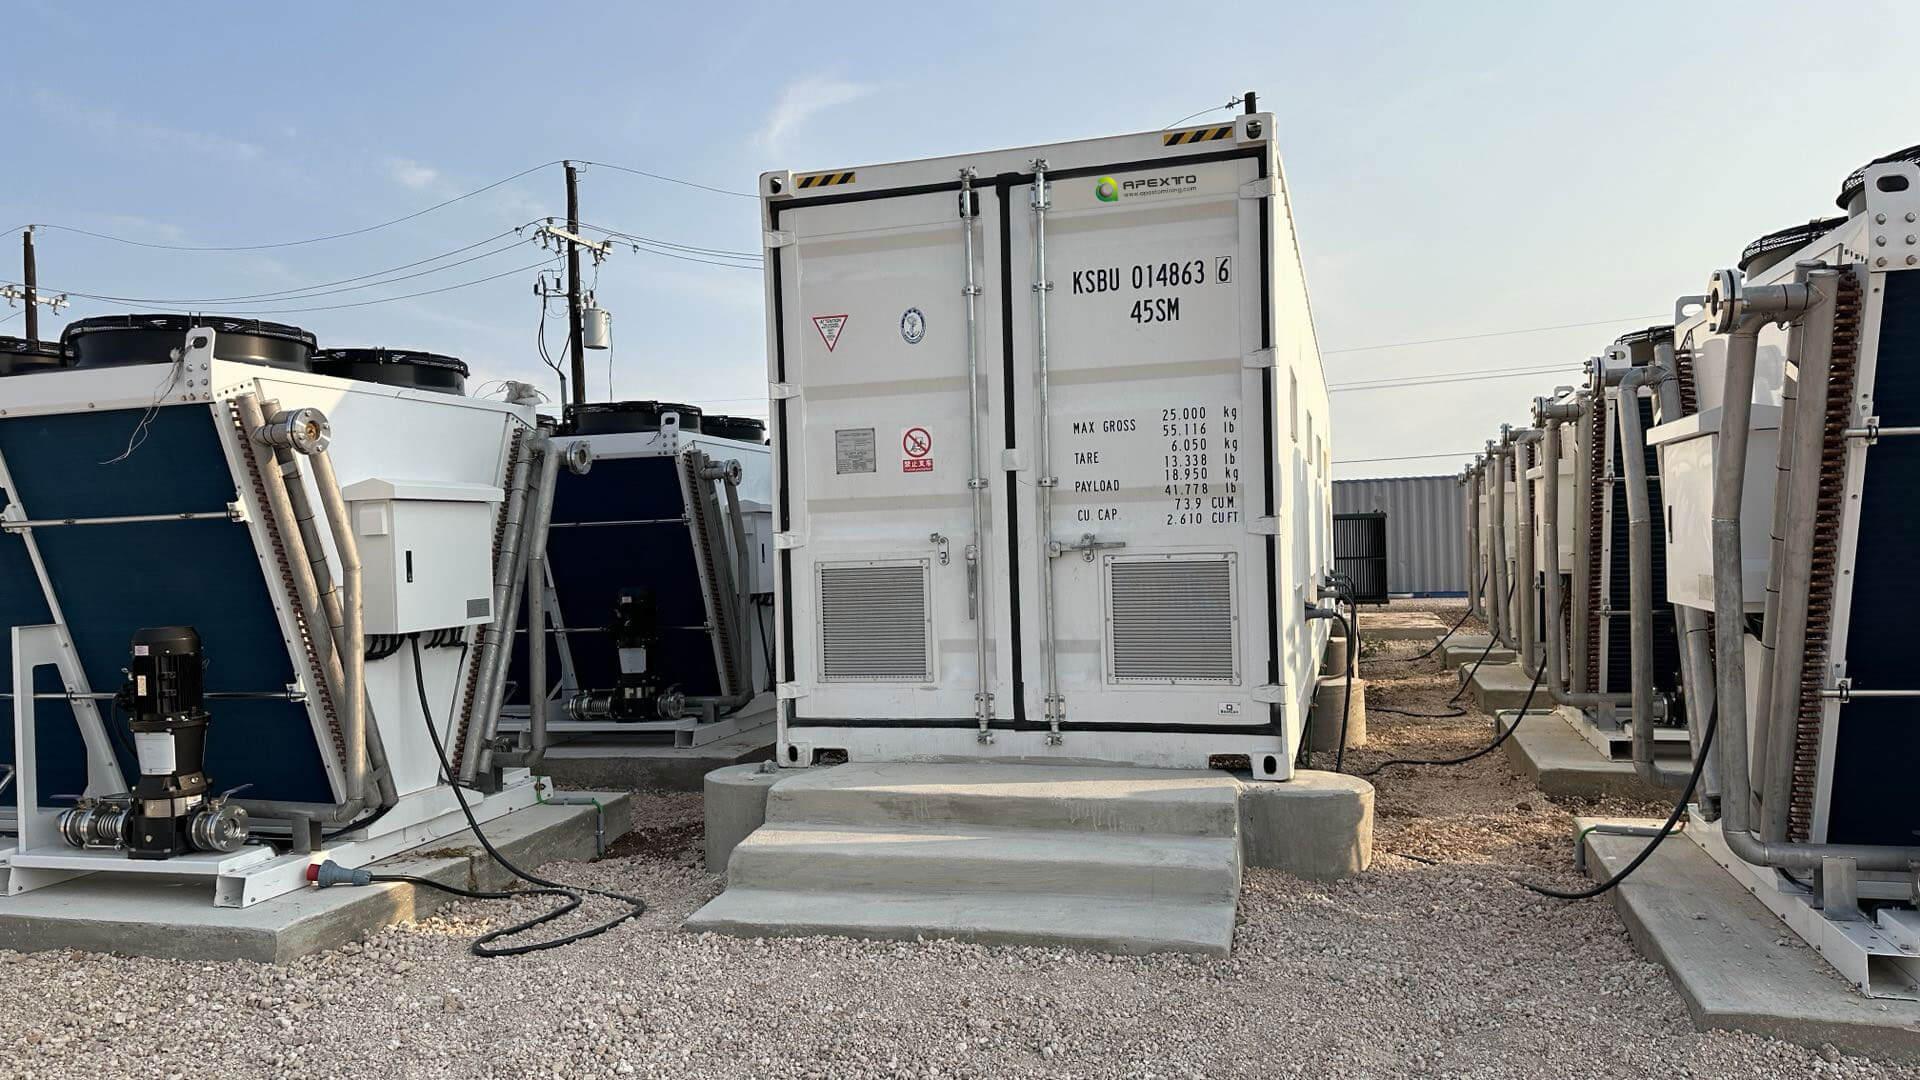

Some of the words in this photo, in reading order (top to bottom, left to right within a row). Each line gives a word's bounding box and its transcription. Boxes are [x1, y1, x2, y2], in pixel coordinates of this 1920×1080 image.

[1123, 175, 1197, 190] APEXTO
[1073, 267, 1120, 294] KSBU
[1132, 260, 1205, 289] 014863
[1218, 258, 1229, 282] 6
[1130, 297, 1180, 323] 45SM
[1162, 407, 1206, 421] 25.000
[1223, 406, 1237, 420] kg
[1073, 421, 1095, 434] MAX
[1103, 419, 1136, 432] GROSS
[1163, 423, 1206, 436] 55.116
[1224, 421, 1235, 433] lb
[1171, 438, 1207, 451] 6.050
[1224, 437, 1238, 452] kg
[1074, 452, 1099, 464] TARE
[1165, 454, 1207, 467] 13.338
[1225, 453, 1235, 464] lb
[1165, 467, 1208, 480] 18.950
[1225, 466, 1239, 481] kg
[1075, 480, 1120, 493] PAYLOAD
[1165, 483, 1208, 495] 41.778
[1225, 482, 1236, 493] lb
[1167, 513, 1203, 525] 2.610
